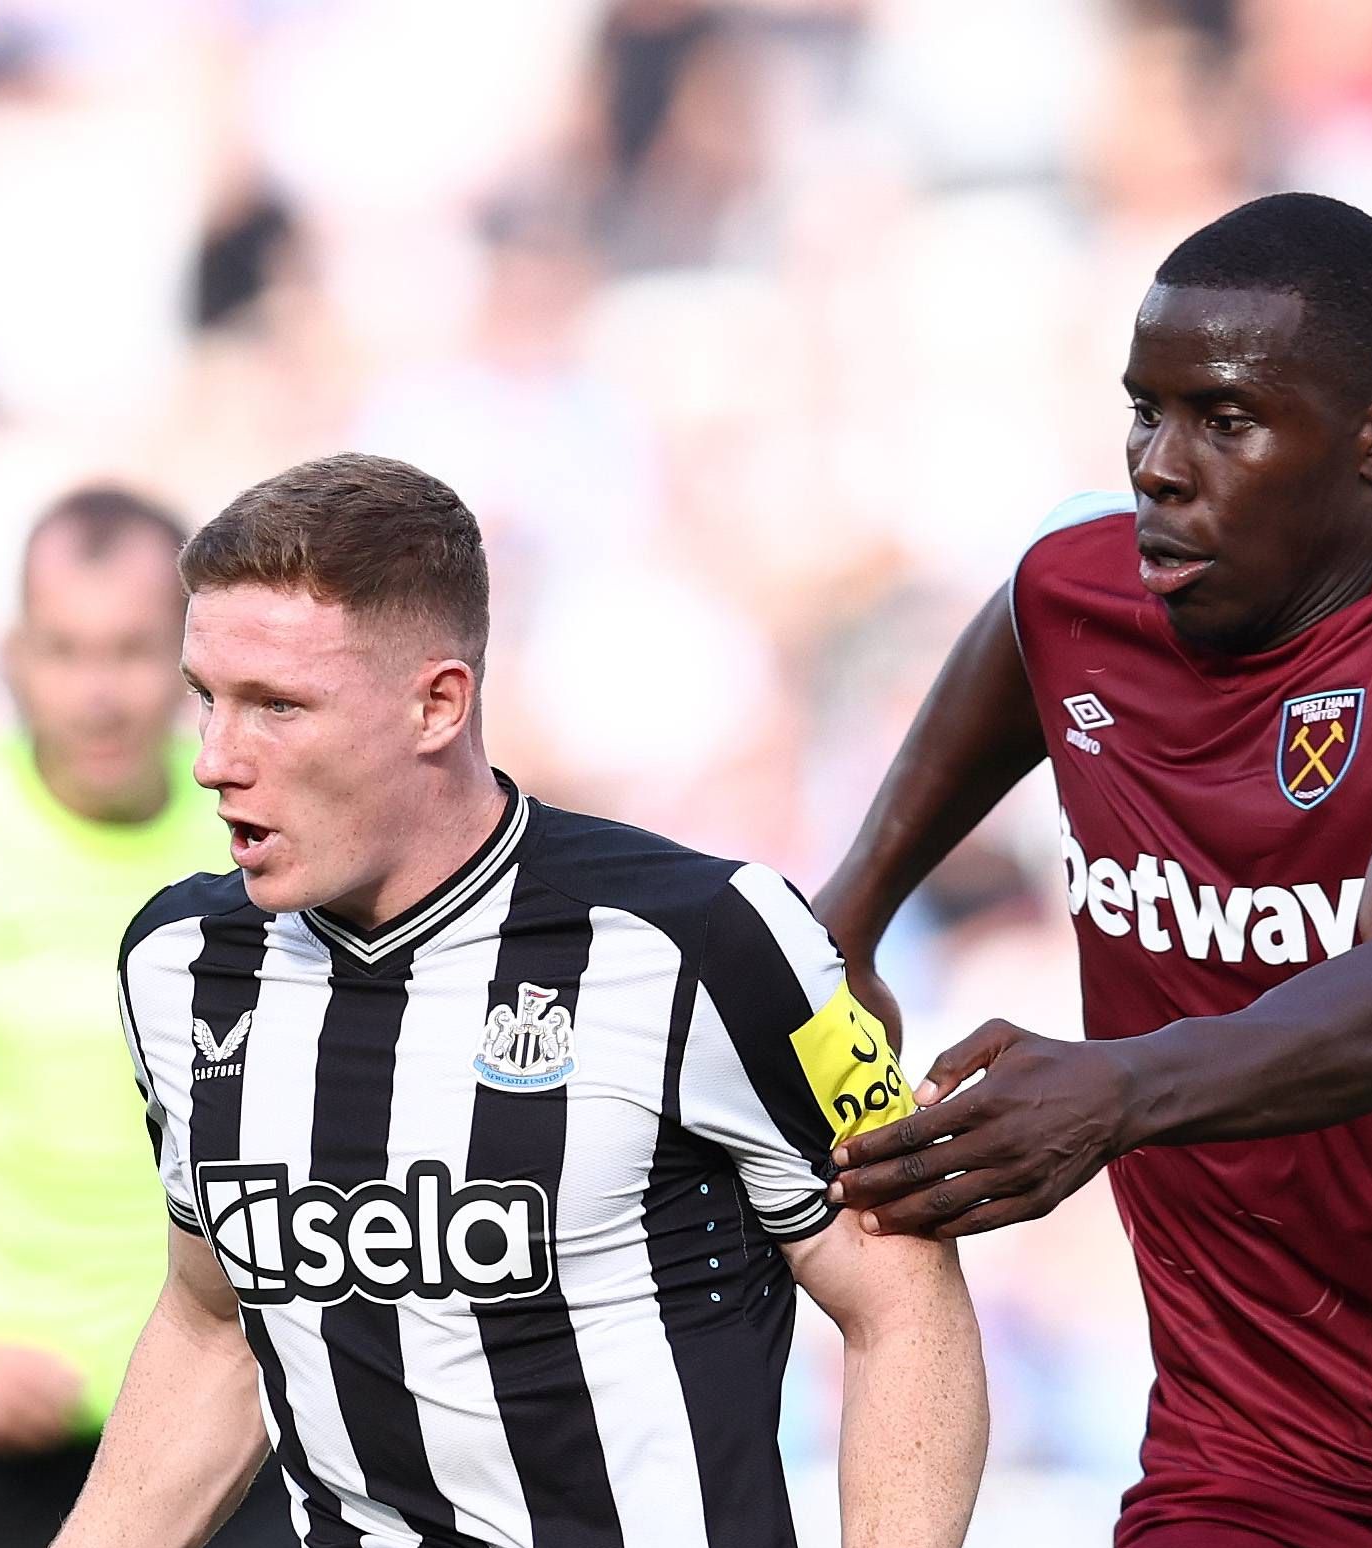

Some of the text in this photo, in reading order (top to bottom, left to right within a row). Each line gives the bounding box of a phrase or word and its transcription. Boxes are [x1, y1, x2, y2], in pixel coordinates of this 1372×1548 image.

[1290, 695, 1355, 717] WEST HAM
[1302, 707, 1342, 724] UNITED
[194, 1063, 243, 1081] CASTORE
[485, 1071, 560, 1085] NEWCASTLE UNITED
